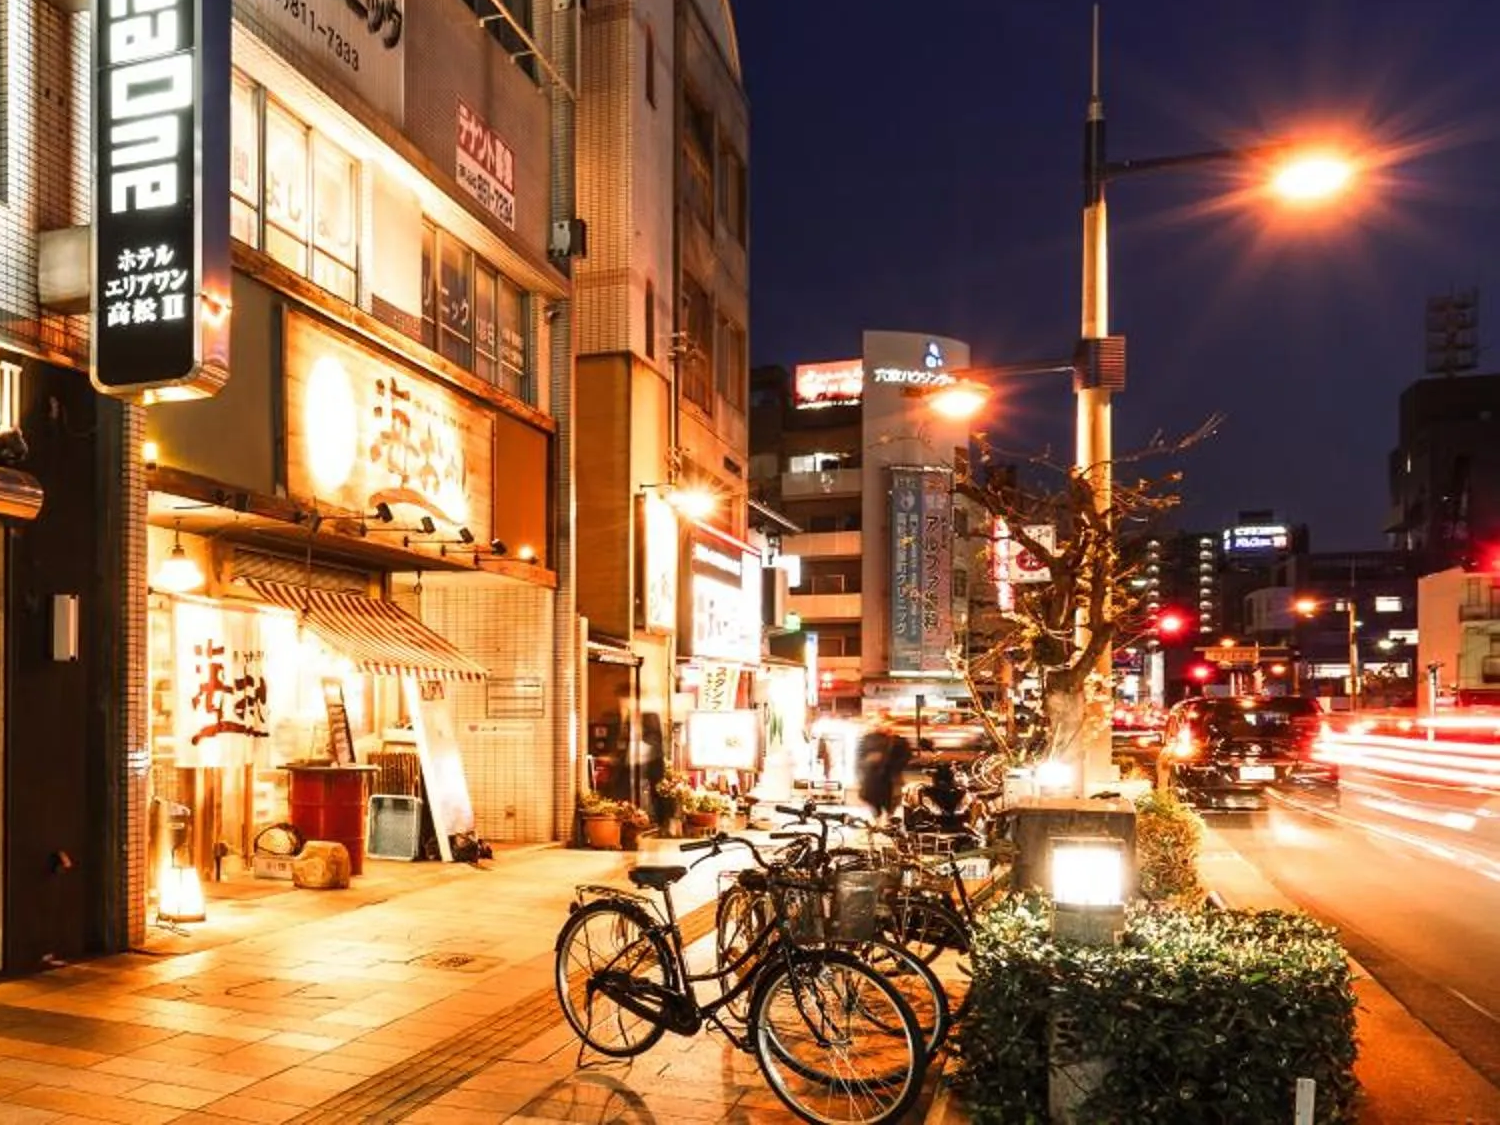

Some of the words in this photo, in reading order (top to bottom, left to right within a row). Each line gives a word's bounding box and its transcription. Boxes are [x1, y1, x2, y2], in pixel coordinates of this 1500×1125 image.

[117, 244, 175, 272] ホテル
[104, 268, 189, 298] エリアワン
